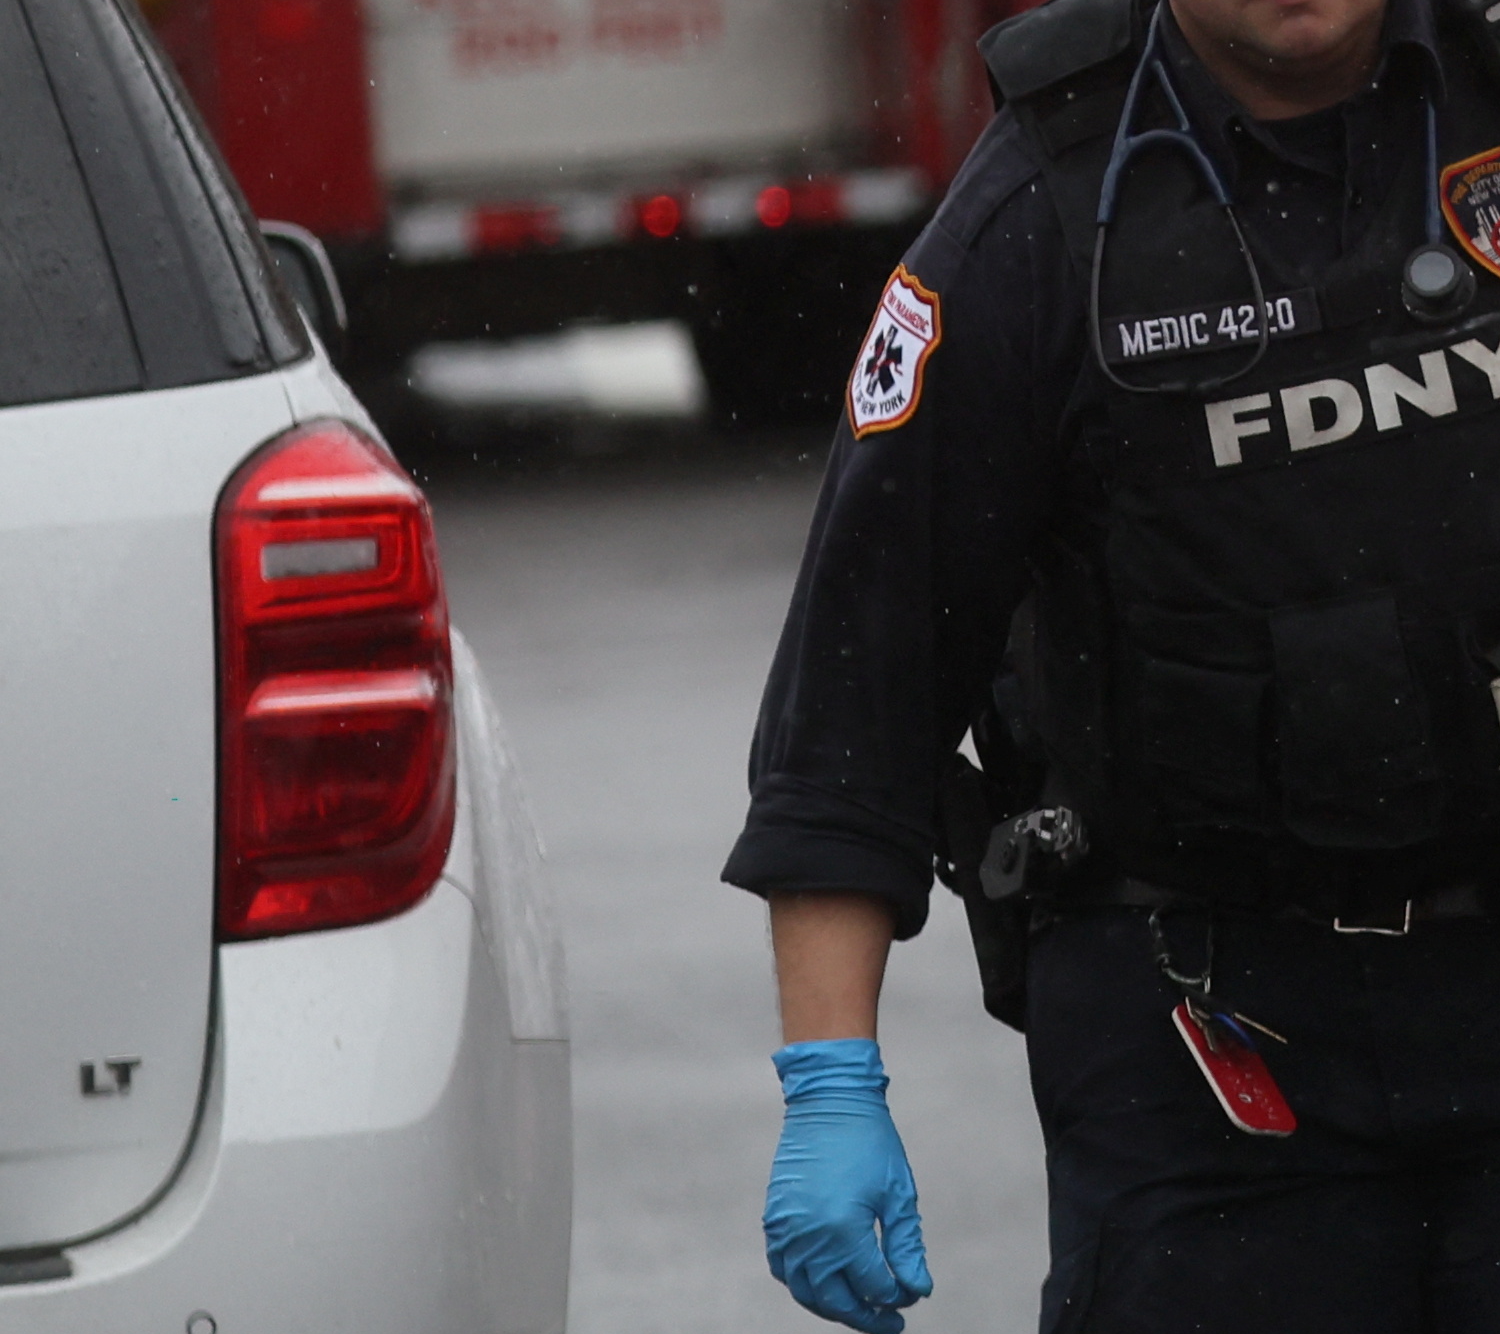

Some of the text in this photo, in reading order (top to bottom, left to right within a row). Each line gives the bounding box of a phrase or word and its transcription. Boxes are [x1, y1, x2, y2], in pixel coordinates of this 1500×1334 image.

[1467, 191, 1490, 206] NEW
[1470, 178, 1493, 193] CITY
[1118, 312, 1210, 358] MEDIC
[877, 389, 907, 417] YORK
[79, 1053, 142, 1098] LT
